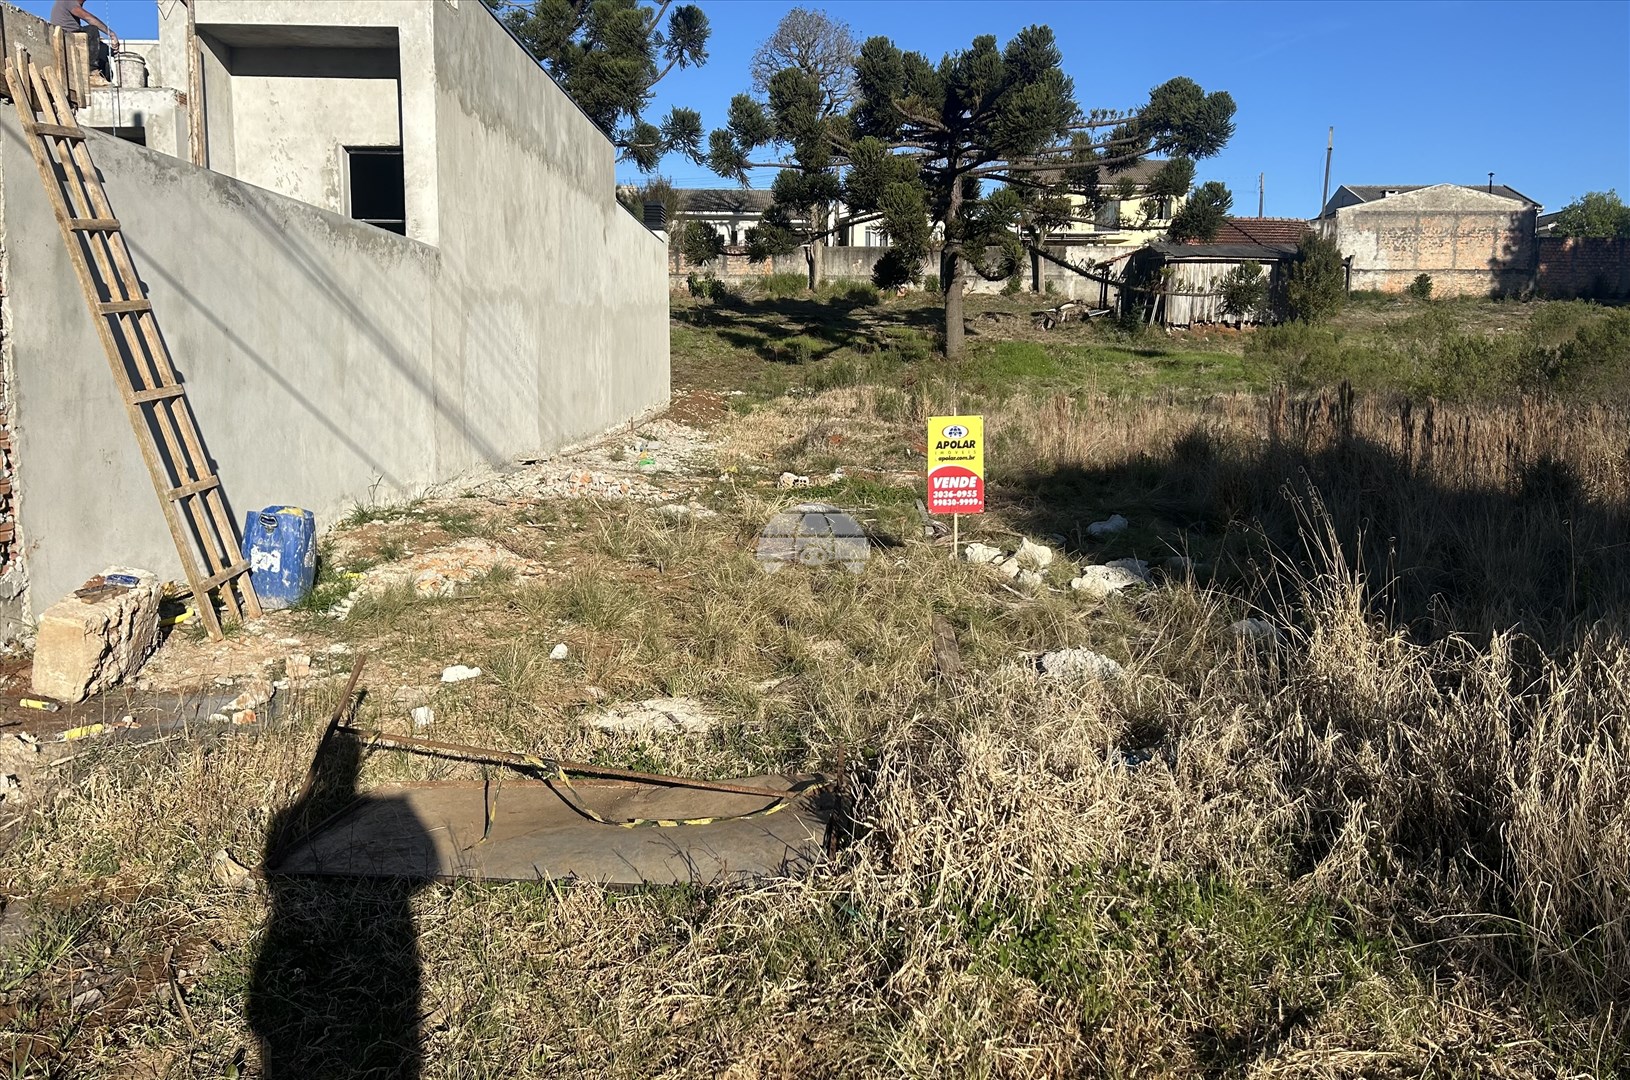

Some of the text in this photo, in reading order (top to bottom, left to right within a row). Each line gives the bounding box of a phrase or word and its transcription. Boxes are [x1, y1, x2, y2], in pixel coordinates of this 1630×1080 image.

[935, 440, 976, 449] APOLAR
[933, 476, 977, 488] VENDE
[933, 490, 977, 498] 3036-0955
